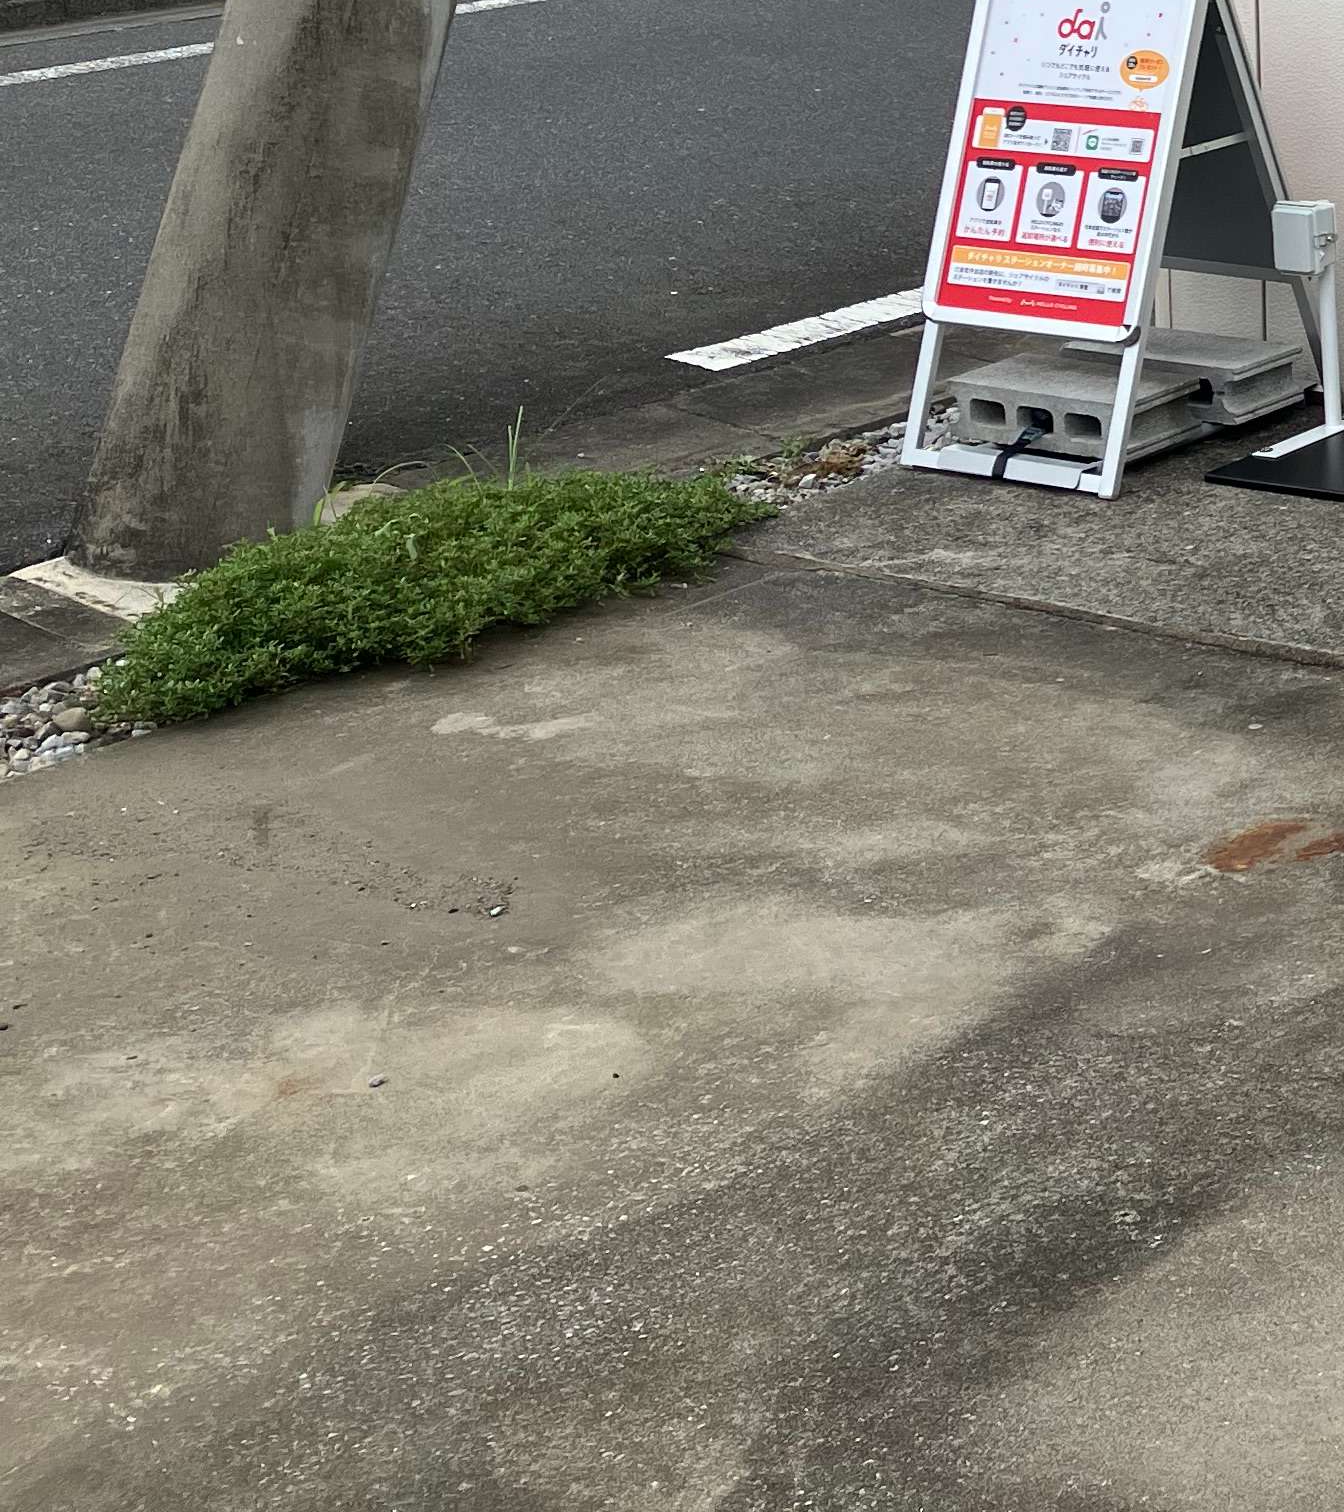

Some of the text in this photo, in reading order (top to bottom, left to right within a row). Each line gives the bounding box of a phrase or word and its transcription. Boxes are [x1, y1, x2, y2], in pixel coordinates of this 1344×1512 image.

[1057, 1, 1111, 40] dai
[1058, 44, 1098, 58] ダイチャリ
